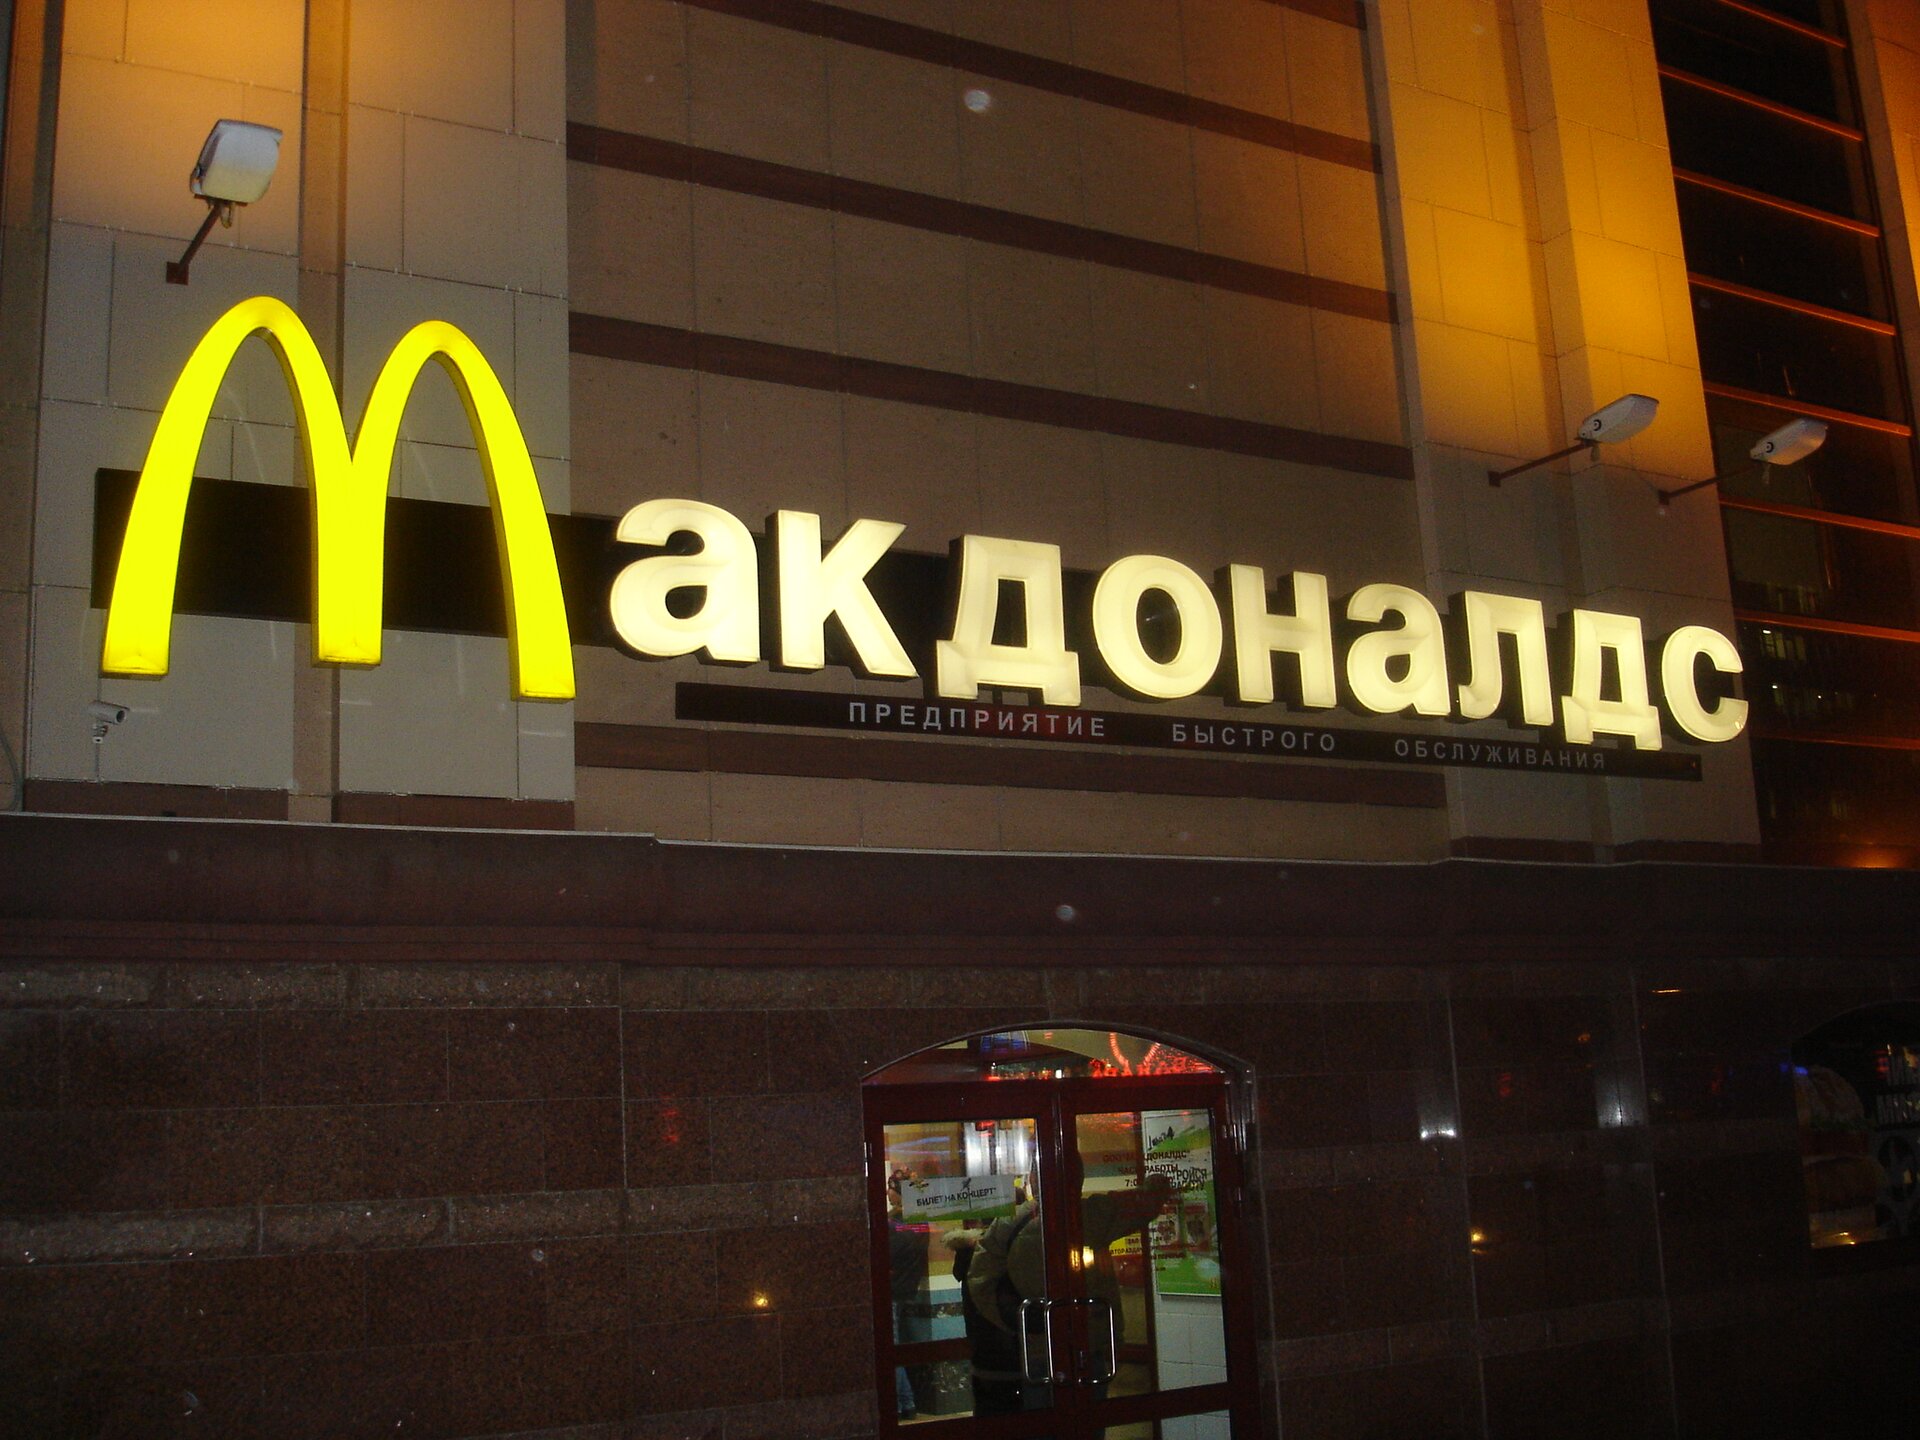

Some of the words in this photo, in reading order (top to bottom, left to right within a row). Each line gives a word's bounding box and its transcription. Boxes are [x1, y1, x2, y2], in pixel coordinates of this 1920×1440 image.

[849, 702, 1105, 737] ПРЕДПРИЯТИЕ
[1172, 723, 1335, 752] БЫСТРОГО
[1394, 738, 1605, 769] ОБСЛУЖИВАНИЯ
[1144, 1163, 1178, 1173] РАБОТЫ
[916, 1195, 944, 1207] БИЛЕТ
[944, 1194, 956, 1203] НА
